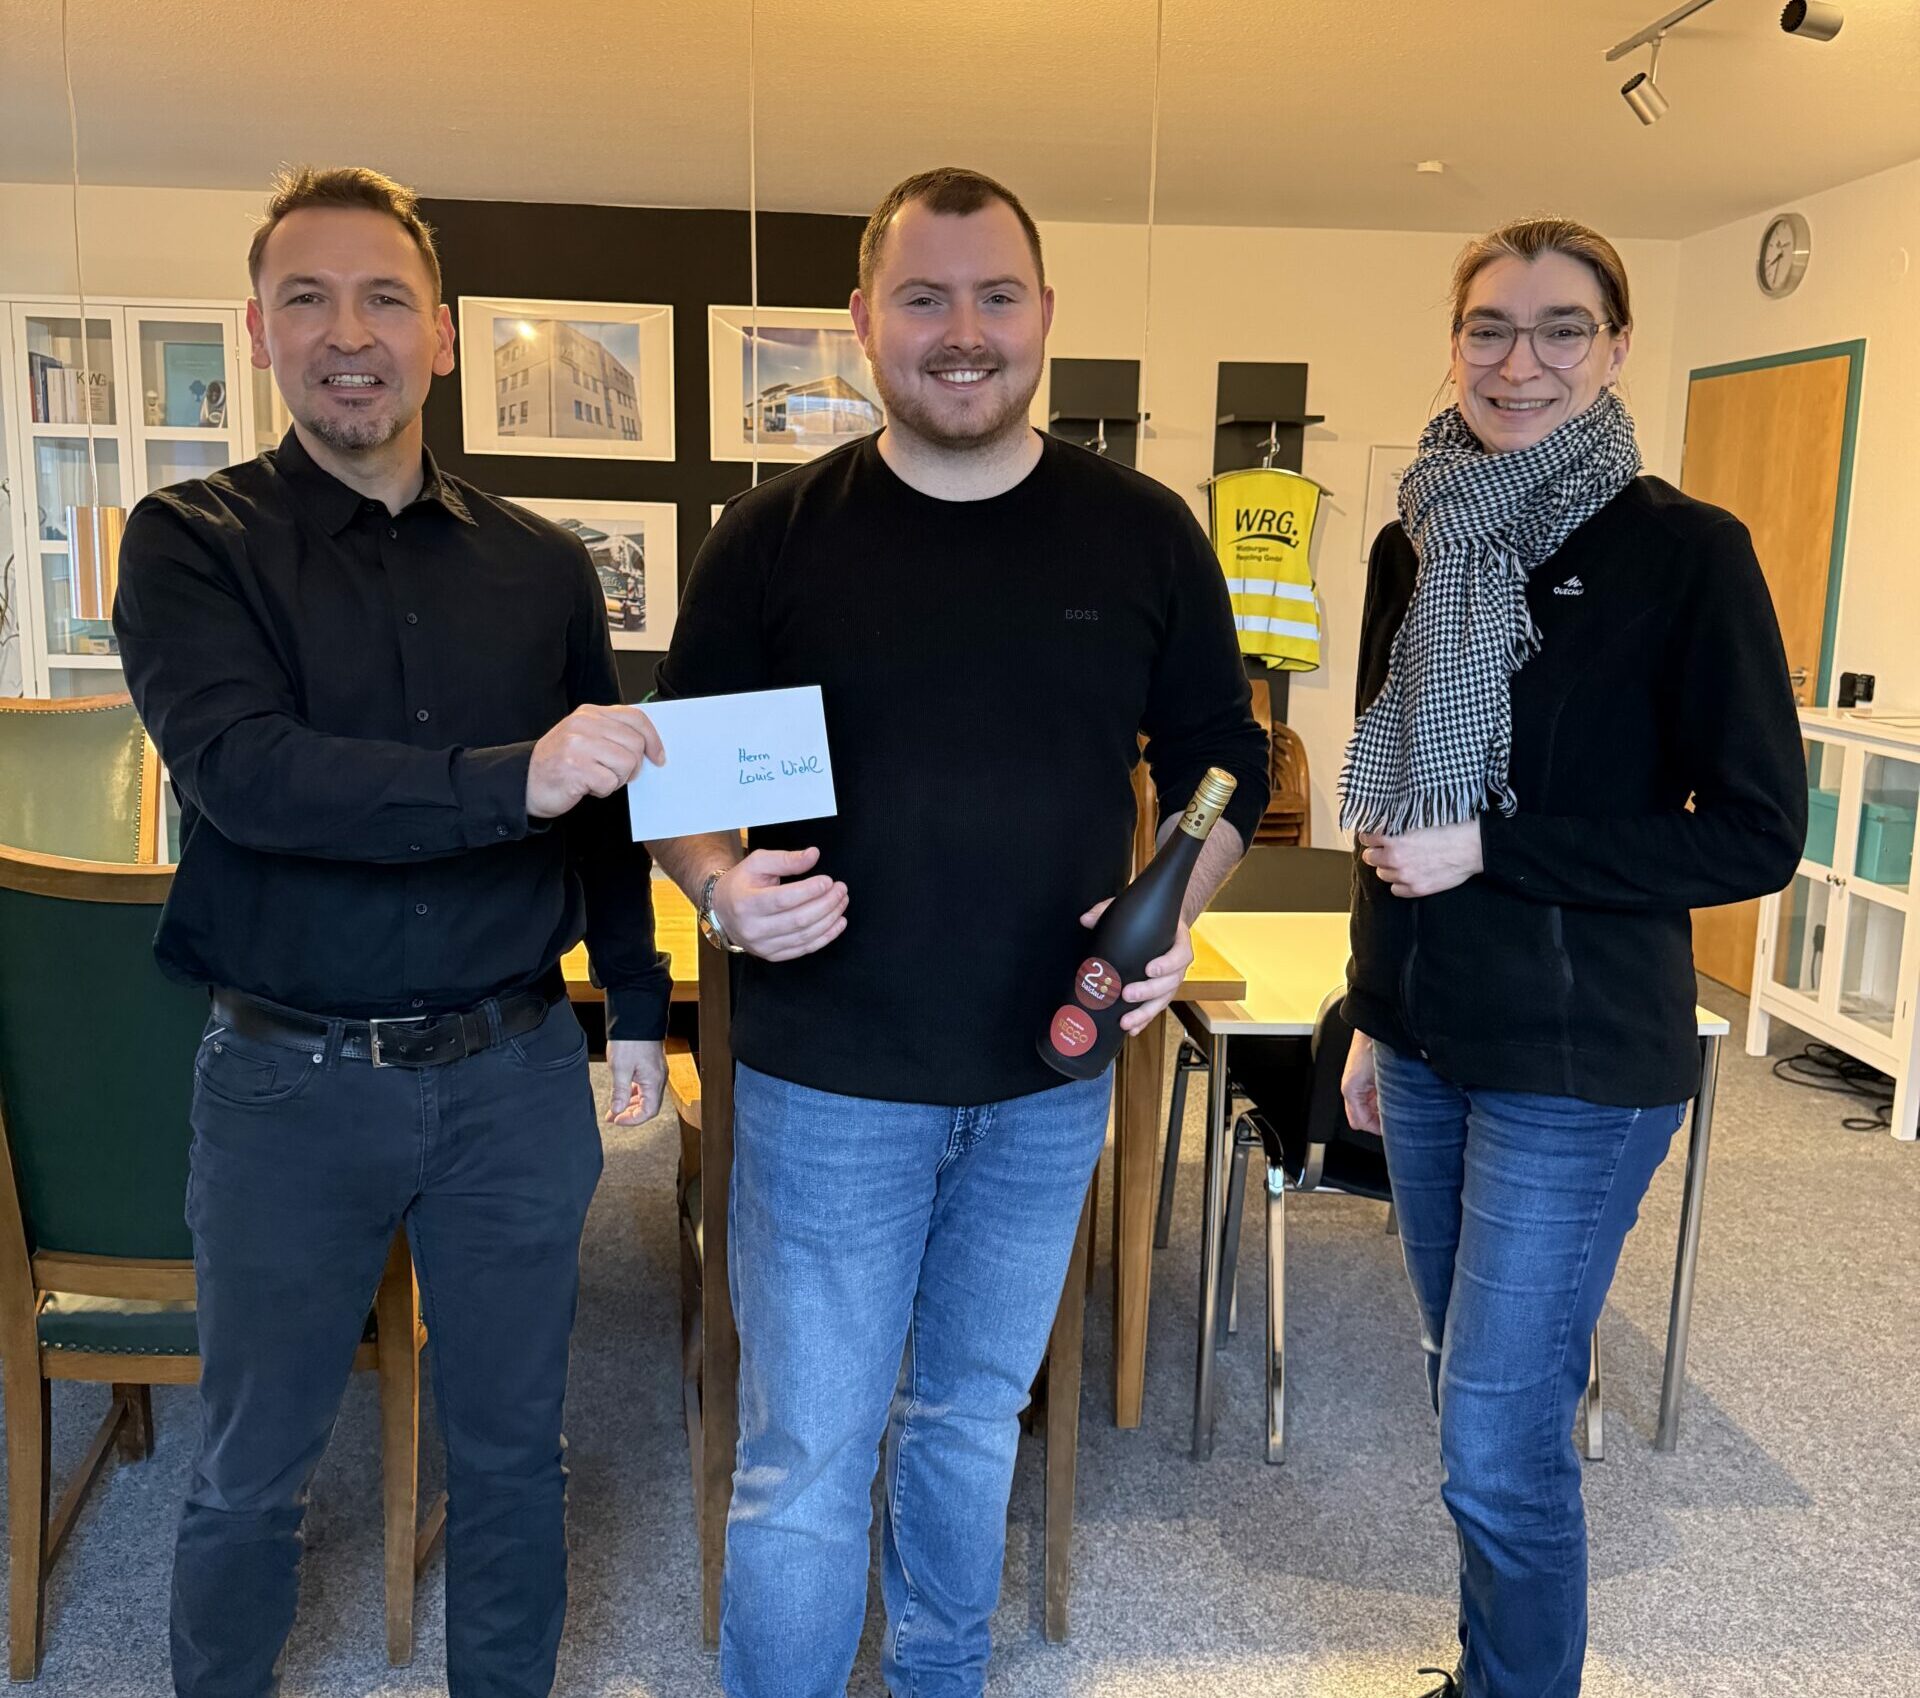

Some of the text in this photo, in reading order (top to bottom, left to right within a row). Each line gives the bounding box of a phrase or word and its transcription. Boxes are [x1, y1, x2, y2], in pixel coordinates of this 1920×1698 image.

[1065, 608, 1099, 621] BOSS
[738, 747, 770, 763] Herrn
[739, 766, 775, 785] Louis
